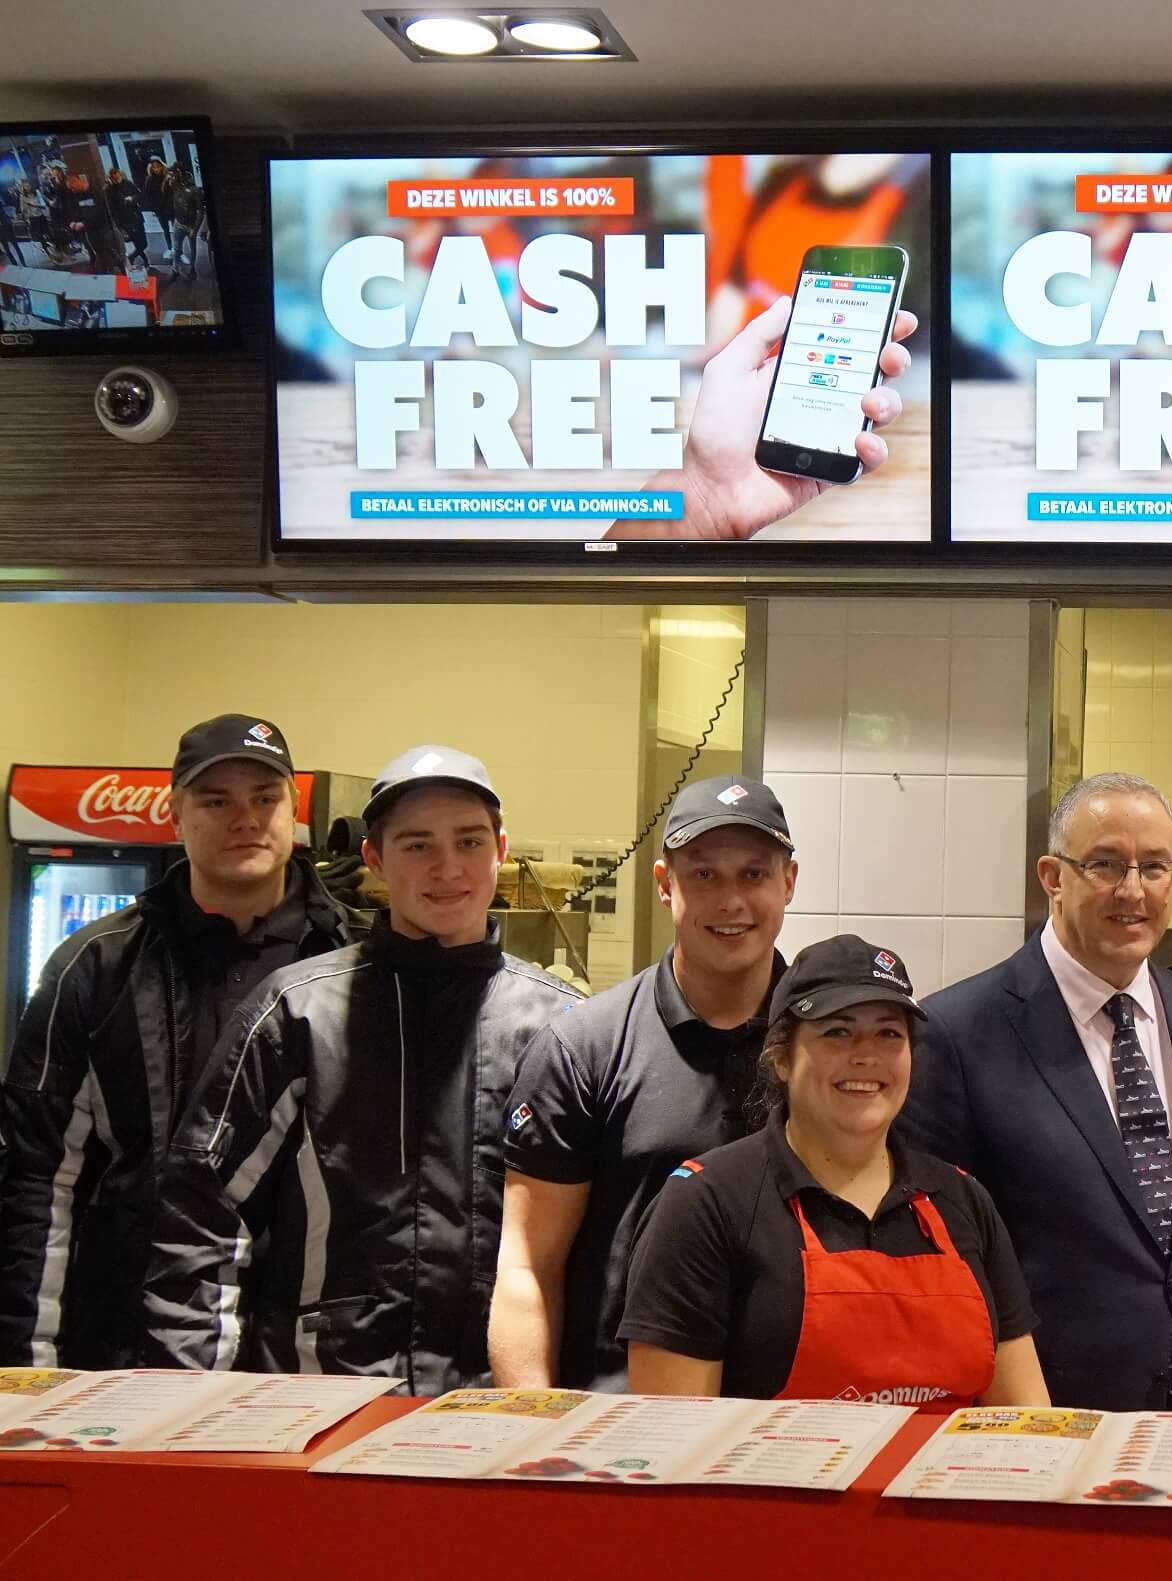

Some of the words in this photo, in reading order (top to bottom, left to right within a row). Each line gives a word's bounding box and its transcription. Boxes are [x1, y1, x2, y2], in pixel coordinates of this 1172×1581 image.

[407, 189, 455, 208] DEZE
[460, 188, 535, 207] WINKEL
[539, 188, 558, 207] IS
[563, 187, 615, 207] 100%
[1096, 184, 1147, 204] DEZE
[321, 233, 706, 349] CASH
[355, 359, 683, 470] FREE
[362, 498, 414, 513] BETAAL
[418, 498, 524, 513] ELEKTRONISCH
[528, 498, 547, 513] OF
[551, 499, 576, 513] VIA
[579, 499, 672, 513] DOMINOS.NL
[1039, 500, 1096, 515] BETAAL
